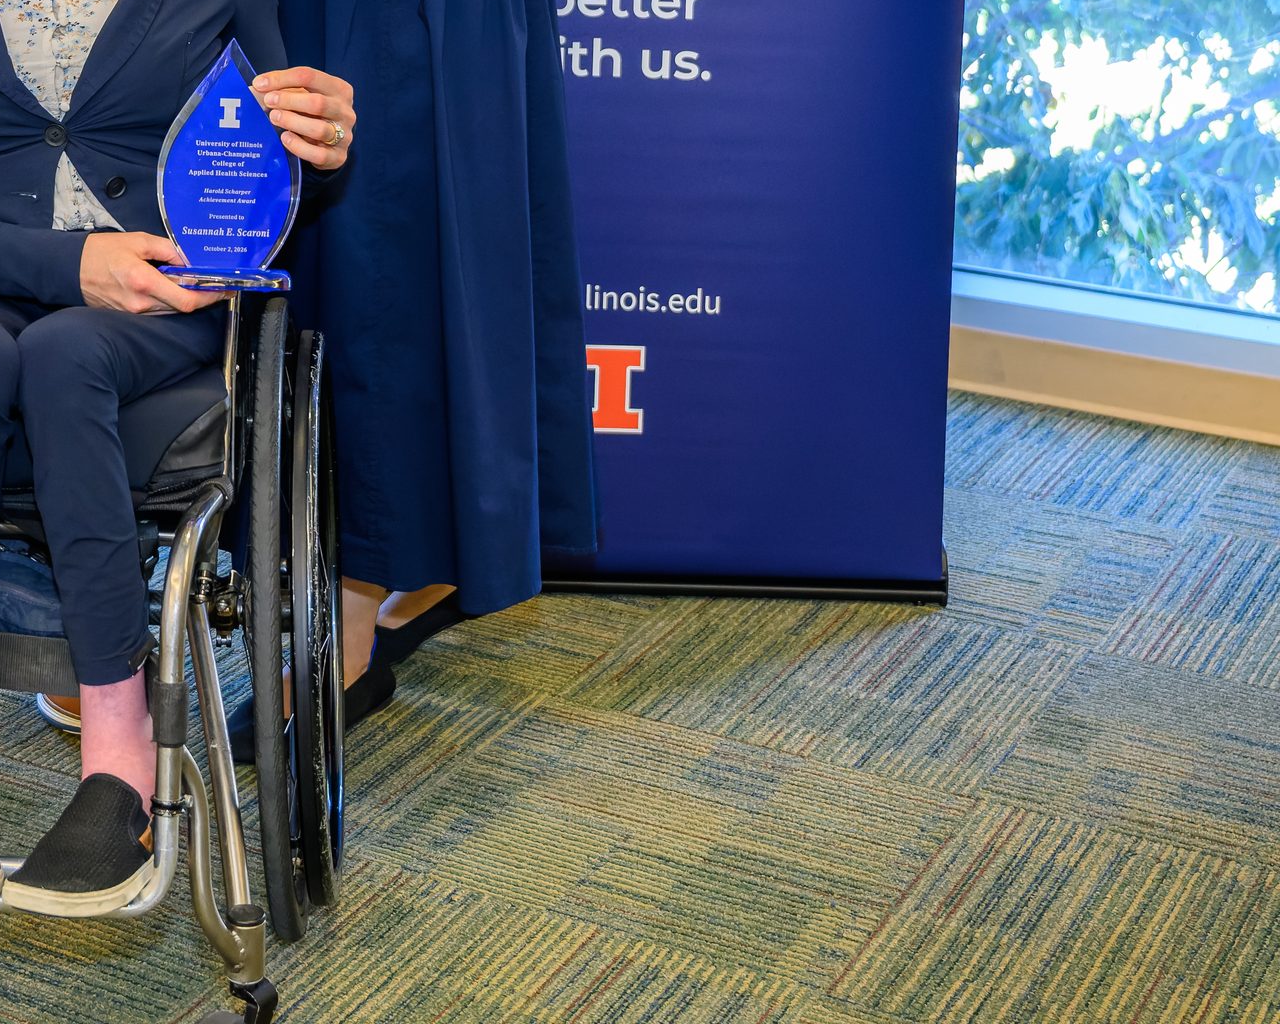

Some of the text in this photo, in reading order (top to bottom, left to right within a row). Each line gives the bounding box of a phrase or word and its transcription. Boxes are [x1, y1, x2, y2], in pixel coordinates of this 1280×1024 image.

[641, 49, 712, 81] us.
[219, 97, 241, 128] I
[195, 140, 230, 148] University
[197, 149, 261, 159] Urbana-Champaign
[224, 188, 251, 196] Scharper
[182, 226, 270, 238] Susannah E. Scaroni
[203, 245, 226, 253] October
[585, 283, 721, 316] linois.edu
[585, 344, 646, 435] I
